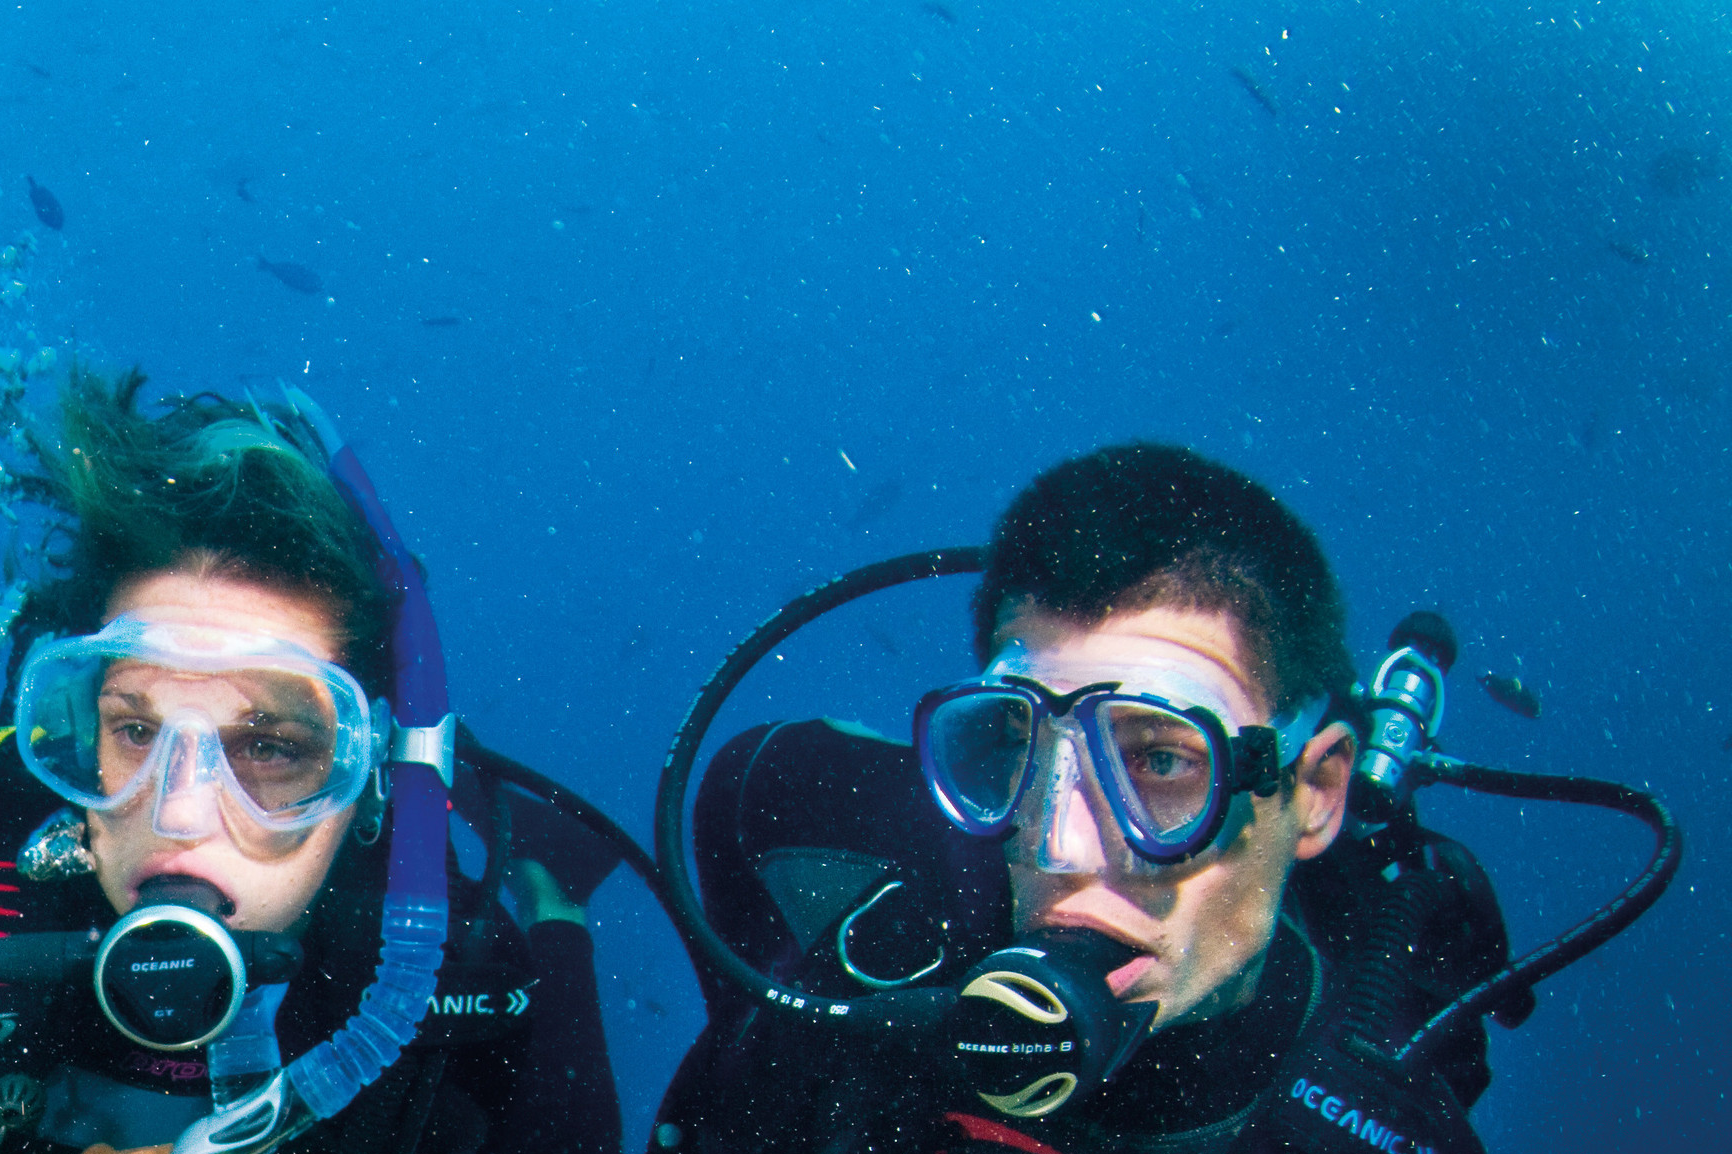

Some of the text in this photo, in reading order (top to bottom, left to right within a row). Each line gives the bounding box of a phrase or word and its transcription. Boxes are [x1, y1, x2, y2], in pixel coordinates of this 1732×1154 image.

[131, 959, 195, 972] OCEANIC
[426, 994, 489, 1014] ANIC
[957, 1042, 1008, 1054] OCEANIC
